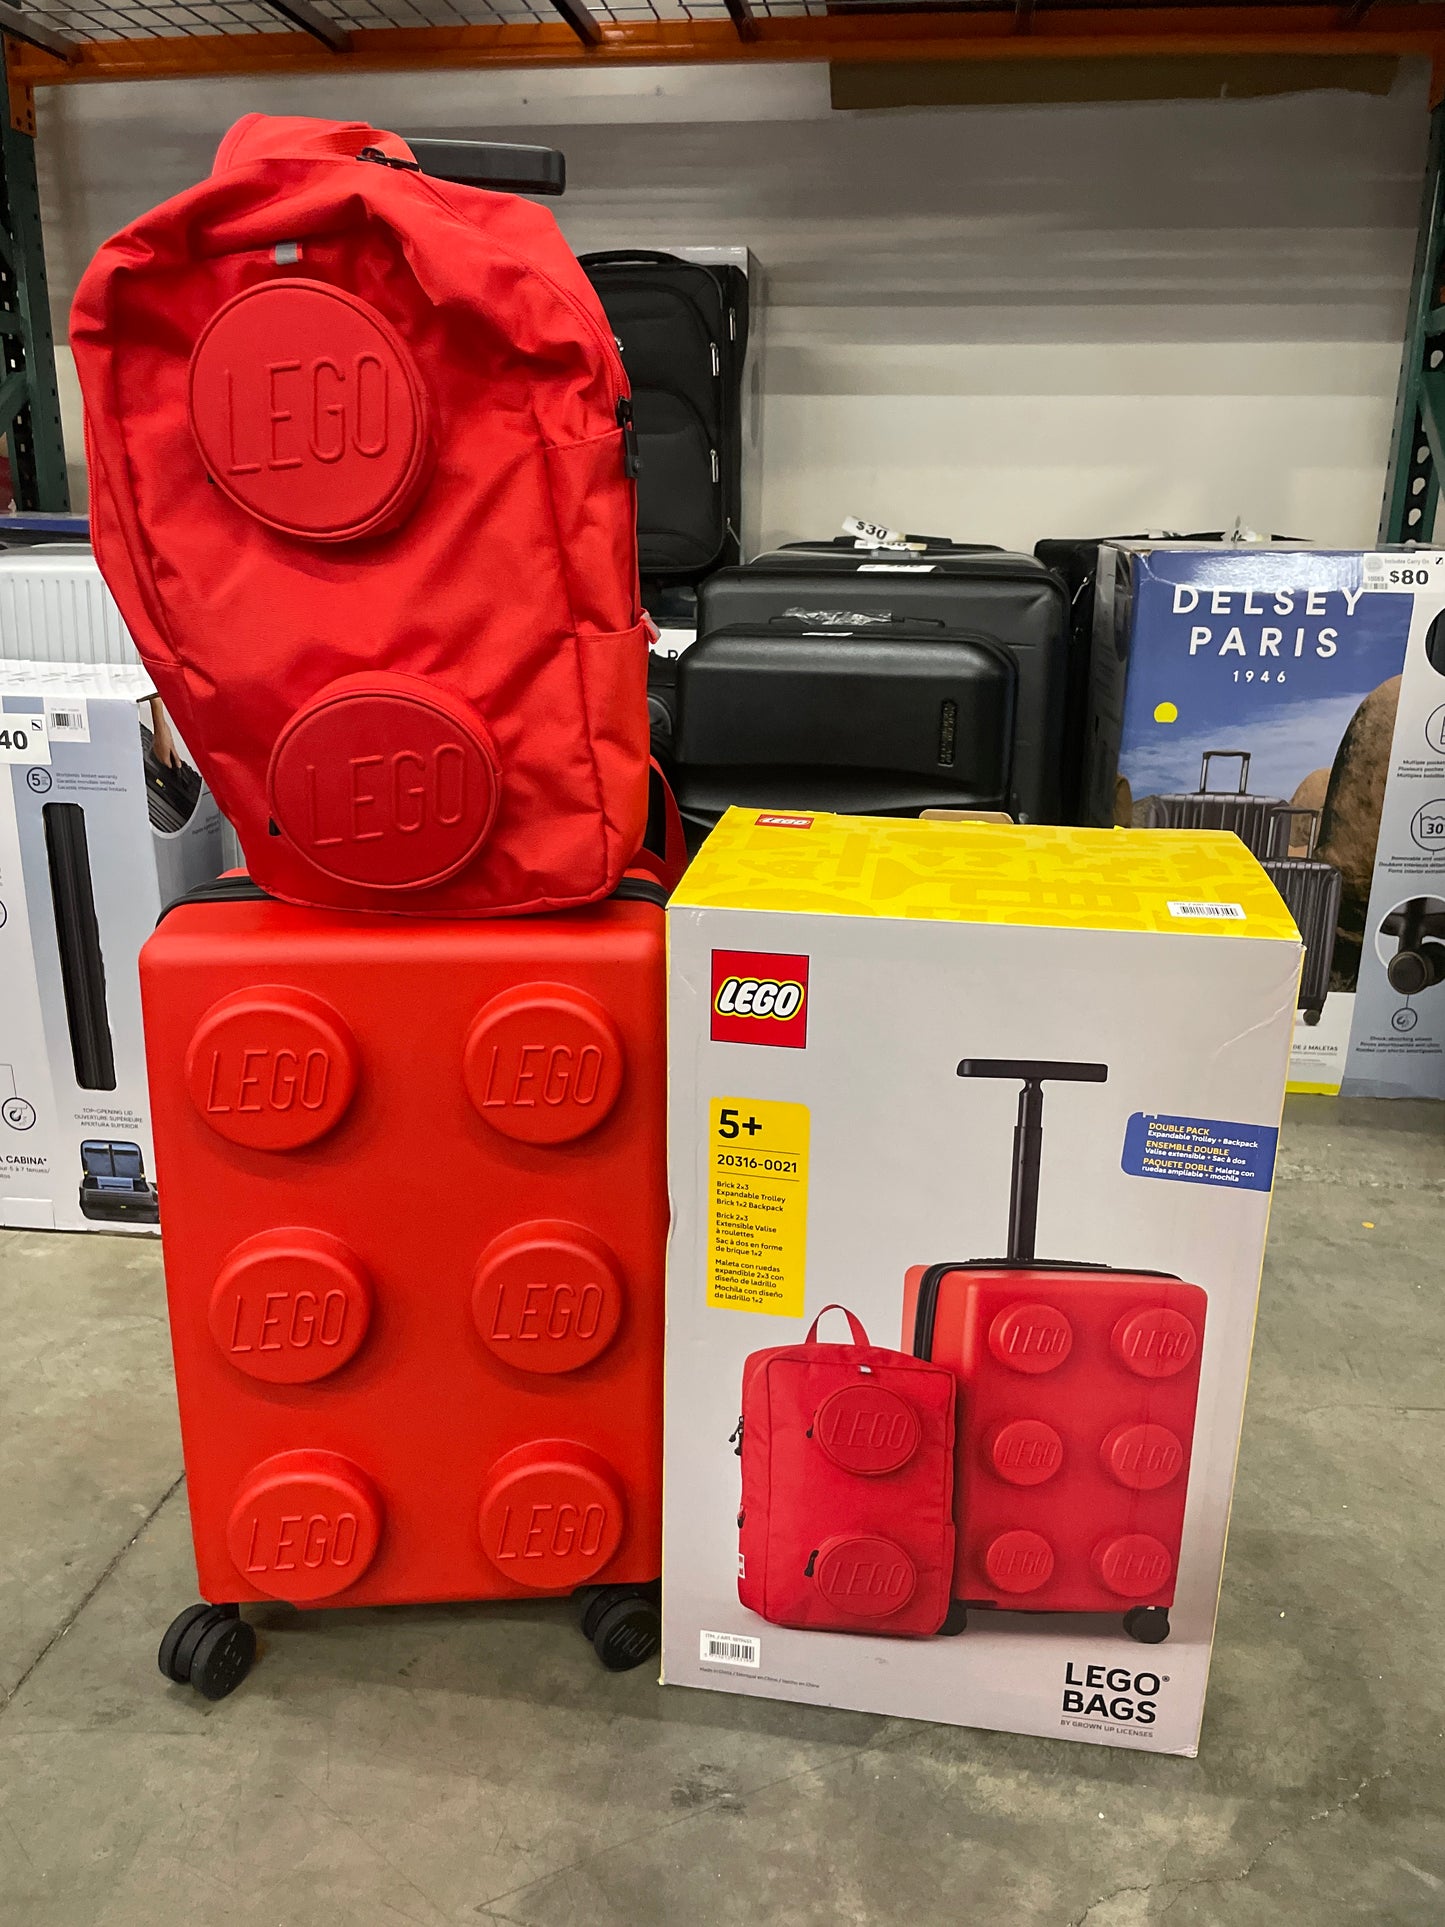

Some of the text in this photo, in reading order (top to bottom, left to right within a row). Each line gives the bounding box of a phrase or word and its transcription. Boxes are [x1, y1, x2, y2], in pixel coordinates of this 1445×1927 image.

[224, 352, 389, 476] LEGO
[856, 521, 888, 540] $30
[1389, 569, 1429, 585] $80
[1173, 584, 1364, 617] DELSEY
[1189, 627, 1339, 658] PARIS
[1233, 670, 1286, 683] 1946
[31, 773, 41, 787] 5
[306, 743, 466, 847] LEGO
[761, 817, 810, 826] LEGO
[717, 977, 802, 1019] LEGO
[207, 1047, 332, 1113] LEGO
[483, 1044, 604, 1108] LEGO
[718, 1108, 763, 1139] 5+
[1149, 1122, 1210, 1136] DOUBLE PACK
[1146, 1140, 1230, 1156] ENSEMBLE DOUBLE
[1148, 1130, 1191, 1141] Expandable
[1191, 1134, 1217, 1145] Trolley
[1222, 1138, 1259, 1148] Backpack
[717, 1154, 798, 1173] 20316-0021
[1145, 1148, 1167, 1156] Valise
[1168, 1150, 1206, 1160] extensible
[1212, 1155, 1226, 1163] Sac
[1232, 1157, 1246, 1165] dos
[1142, 1165, 1166, 1174] ruedas
[1167, 1169, 1204, 1178] ampliable
[1210, 1173, 1240, 1182] mochila
[1143, 1157, 1183, 1169] PAQUETE
[1185, 1162, 1214, 1173] DOBLE
[1215, 1166, 1240, 1176] Maleta
[716, 1198, 735, 1206] Brick
[748, 1202, 784, 1212] Backpack
[717, 1189, 786, 1203] Expandable Trolley
[716, 1220, 777, 1233] Extensible Valise
[722, 1229, 754, 1238] roulettes
[726, 1247, 750, 1255] brique
[761, 1243, 783, 1251] forme
[715, 1259, 740, 1268] Maleta
[756, 1265, 780, 1273] ruedas
[715, 1267, 756, 1277] expandible
[714, 1284, 743, 1293] Mochila
[759, 1290, 783, 1298] diseño
[715, 1275, 739, 1283] diseño
[751, 1279, 777, 1288] ladrillo
[725, 1293, 751, 1302] ladrillo
[231, 1289, 348, 1352] LEGO
[491, 1283, 604, 1341] LEGO
[1009, 1326, 1067, 1355] LEGO
[1130, 1330, 1190, 1359] LEGO
[829, 1408, 910, 1450] LEGO
[1002, 1440, 1059, 1467] LEGO
[1120, 1444, 1176, 1472] LEGO
[496, 1503, 607, 1559] LEGO
[246, 1512, 358, 1572] LEGO
[996, 1549, 1049, 1576] LEGO
[1111, 1552, 1166, 1580] LEGO
[828, 1561, 908, 1597] LEGO
[1062, 1689, 1157, 1724] BAGS
[1072, 1721, 1102, 1730] GROWN
[1116, 1728, 1153, 1738] LICENSES
